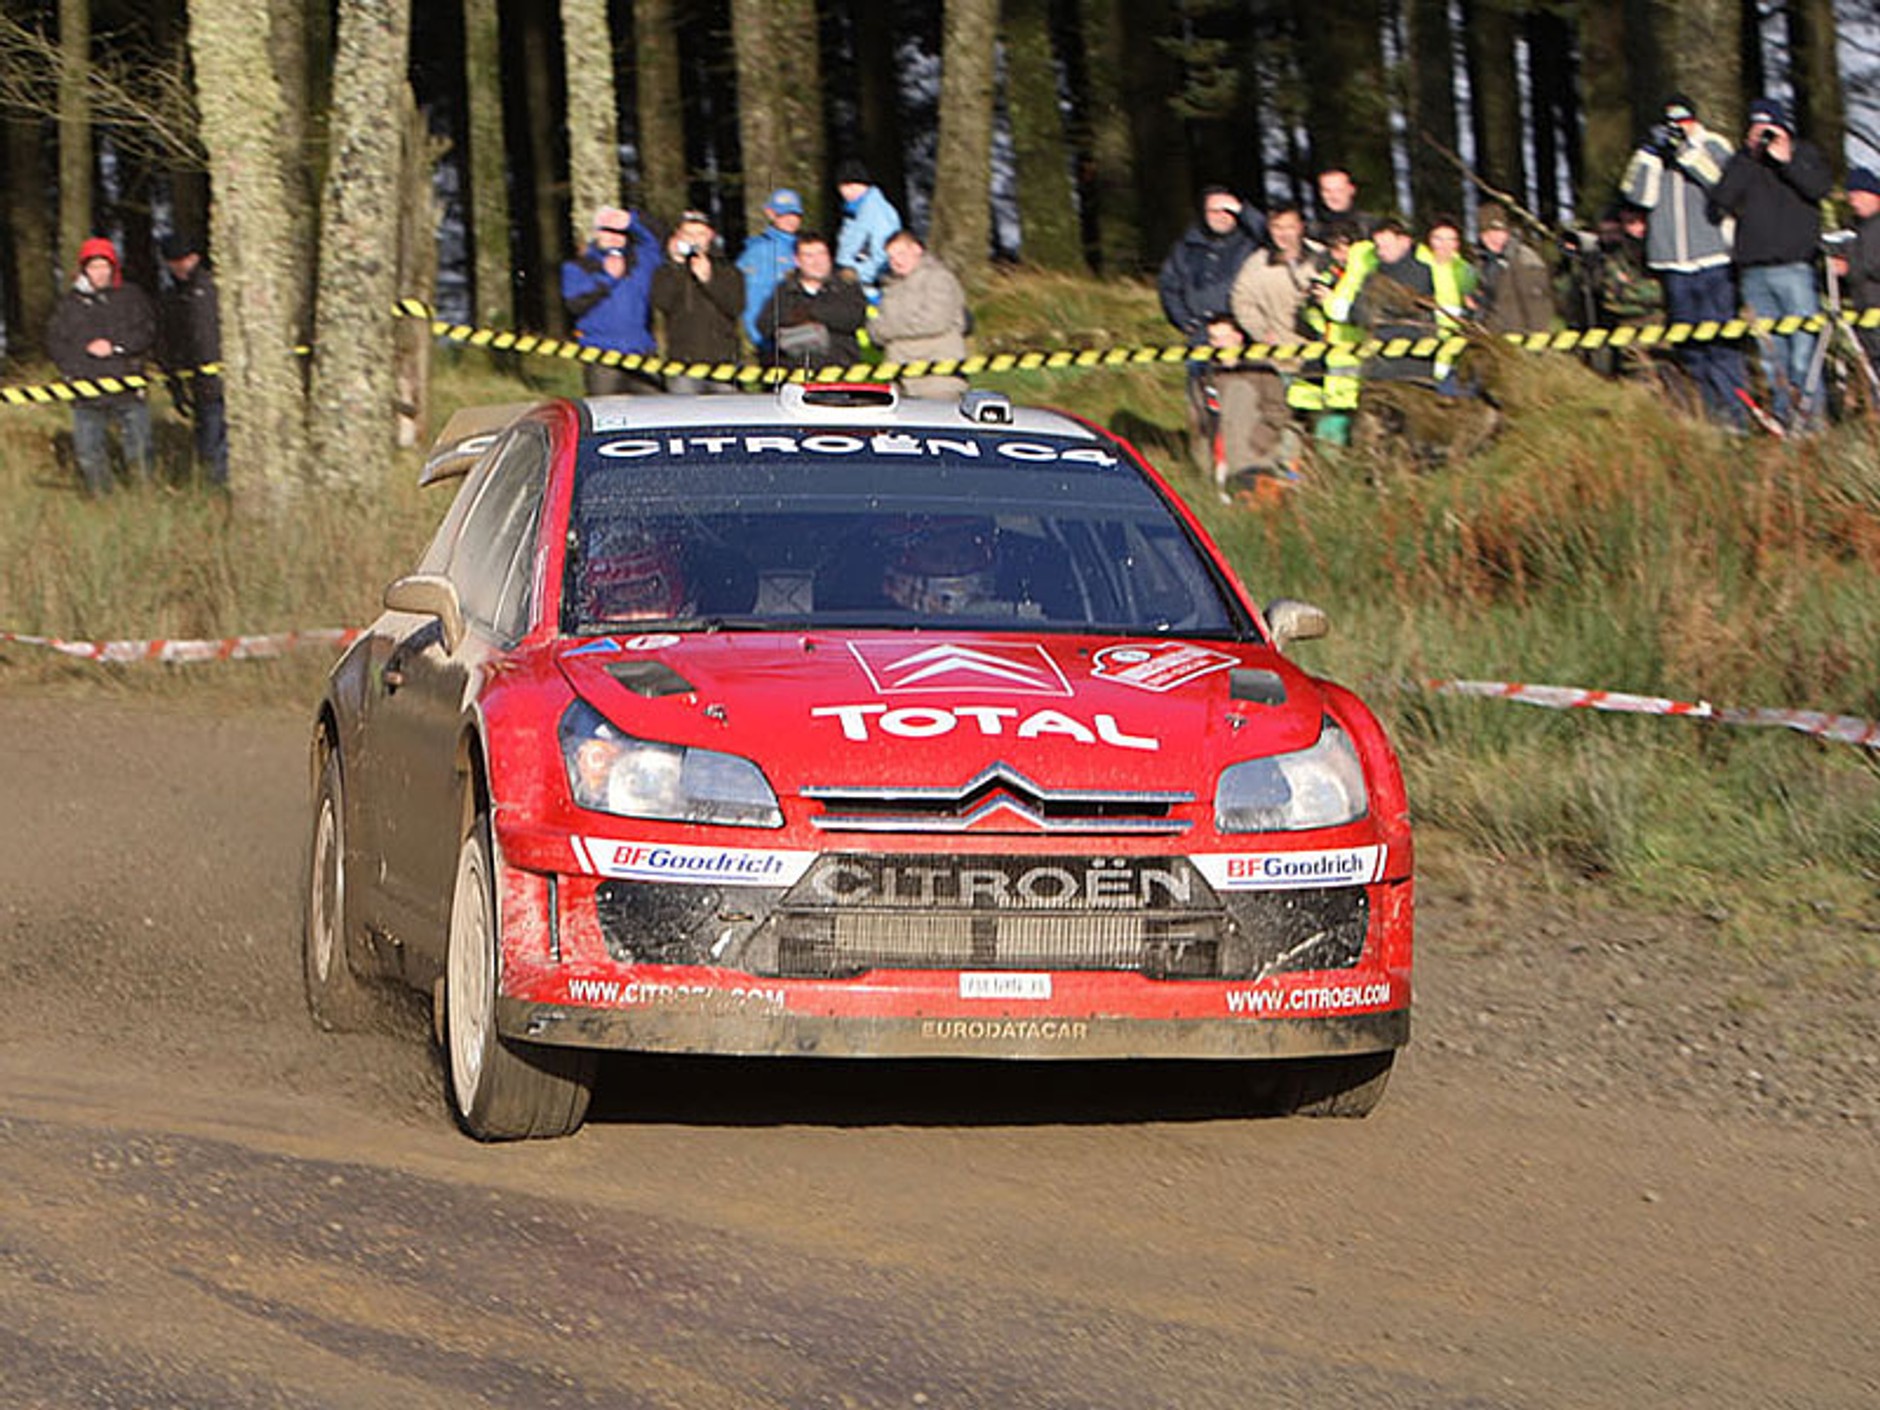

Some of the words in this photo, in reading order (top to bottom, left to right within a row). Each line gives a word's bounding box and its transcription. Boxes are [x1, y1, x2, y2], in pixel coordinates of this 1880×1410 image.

[598, 433, 980, 457] CITROËN
[998, 442, 1118, 467] C4
[812, 703, 1158, 750] TOTAL
[612, 845, 784, 876] BFGoodrich
[1227, 852, 1364, 878] BFGoodrich
[813, 858, 1191, 906] CITROËN
[921, 1021, 1087, 1039] EURODATACAR
